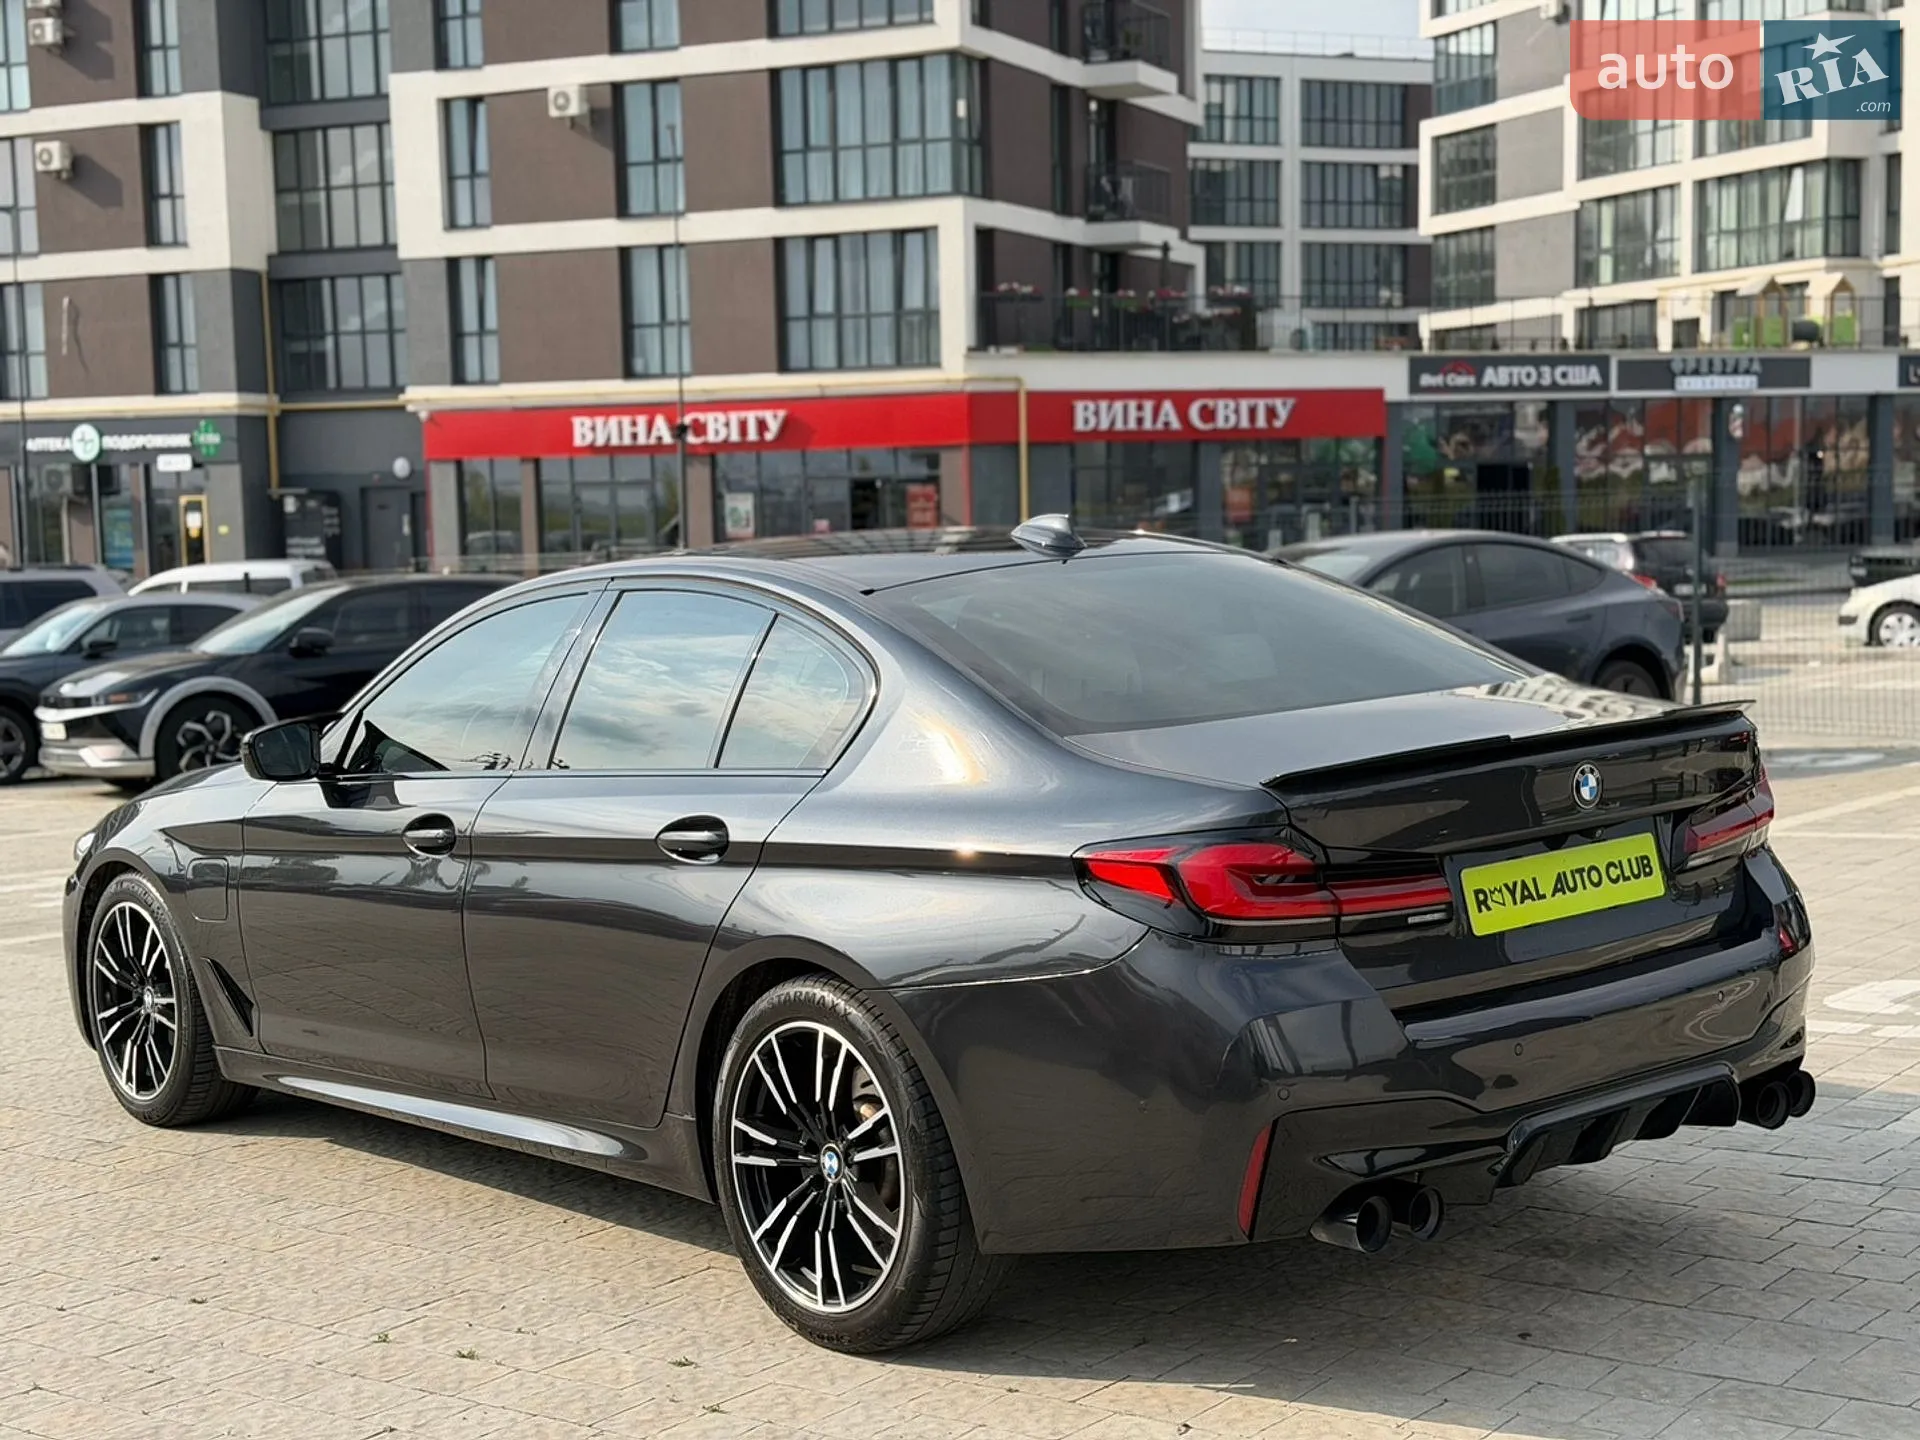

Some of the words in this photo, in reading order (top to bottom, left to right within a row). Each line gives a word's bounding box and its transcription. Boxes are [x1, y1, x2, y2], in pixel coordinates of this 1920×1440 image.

[1481, 365, 1537, 387] АВТО
[1554, 364, 1602, 386] США
[571, 413, 675, 447] ВИНА
[682, 409, 788, 443] СВІТУ
[1073, 399, 1182, 432] ВИНА
[1188, 397, 1296, 431] СВІТУ
[1550, 864, 1604, 898] AUTO
[1605, 854, 1653, 885] CLUB
[764, 989, 852, 1020] STARMAXX
